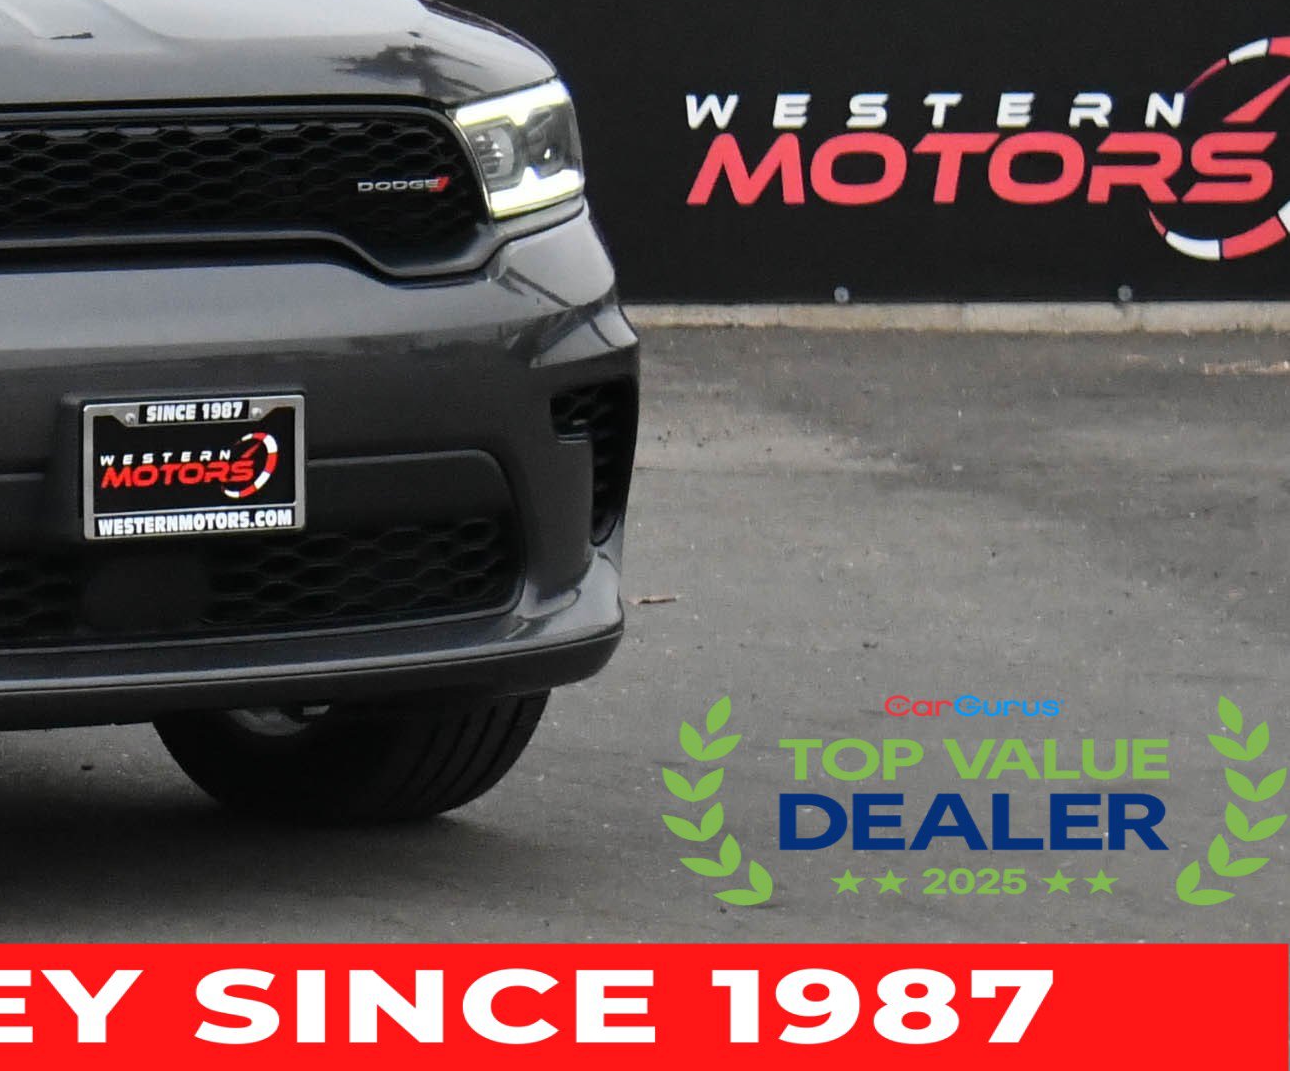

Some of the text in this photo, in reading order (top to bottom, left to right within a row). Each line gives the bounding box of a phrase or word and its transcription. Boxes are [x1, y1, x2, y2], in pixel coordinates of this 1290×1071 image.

[685, 92, 1185, 128] WESTERN
[687, 131, 1276, 205] MOTORS
[357, 178, 440, 193] DODGE
[146, 401, 243, 423] SINCE 1987
[100, 449, 231, 466] WESTERN
[101, 460, 254, 489] MOTORS
[98, 508, 292, 537] WESTERNMOTORS.COM
